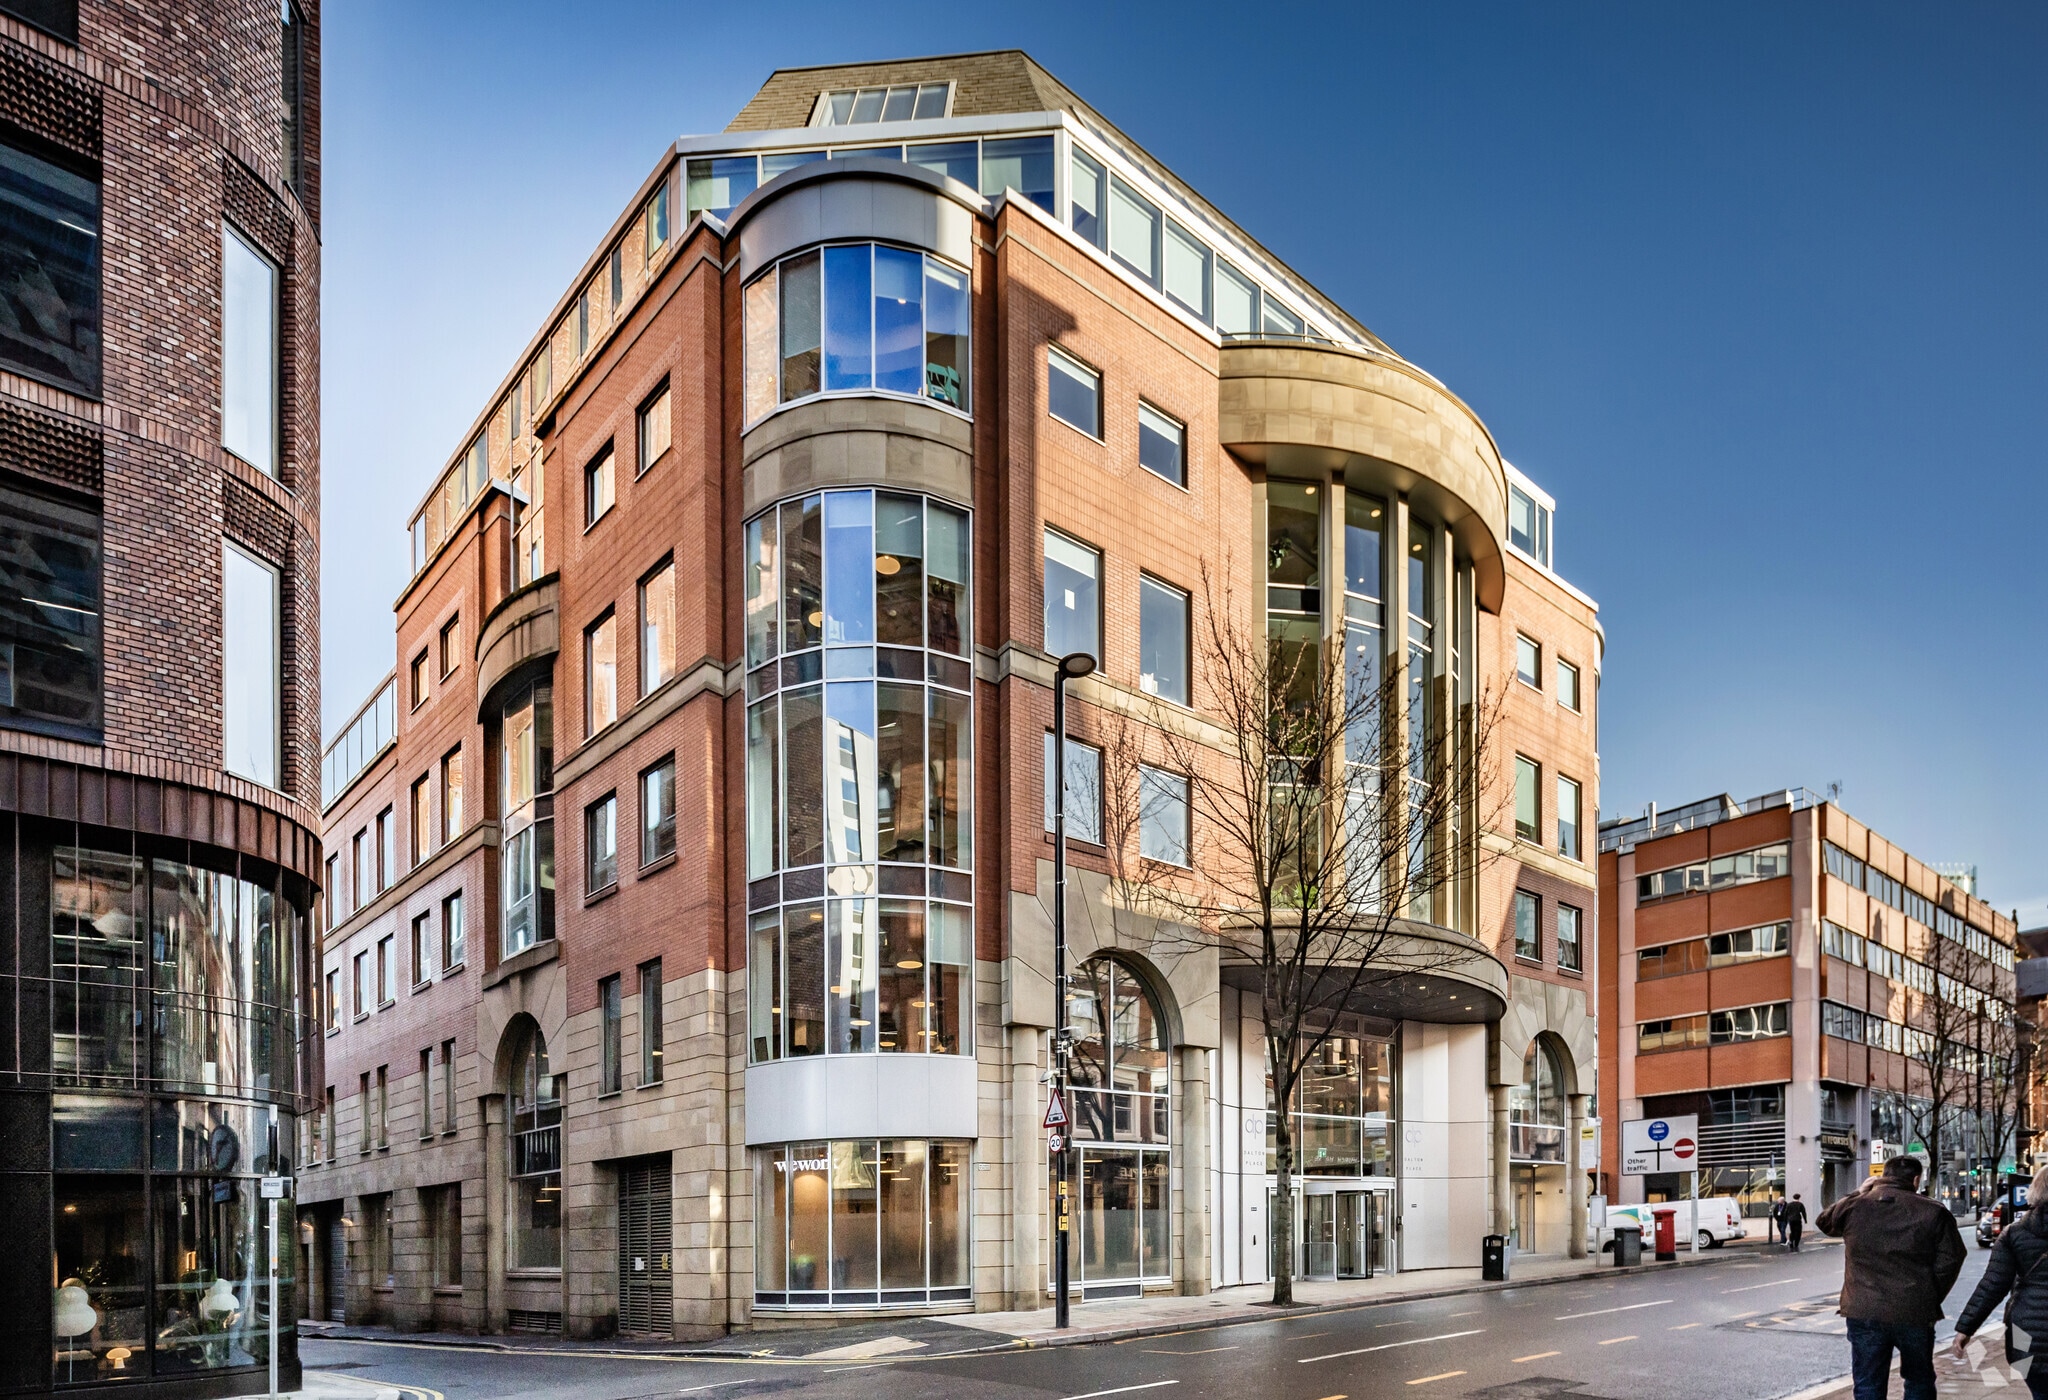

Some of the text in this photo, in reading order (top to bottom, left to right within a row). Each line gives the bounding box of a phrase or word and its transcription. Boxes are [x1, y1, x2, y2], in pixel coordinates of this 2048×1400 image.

[1051, 1138, 1061, 1148] 20
[774, 1153, 841, 1172] wework
[2015, 1186, 2029, 1202] P
